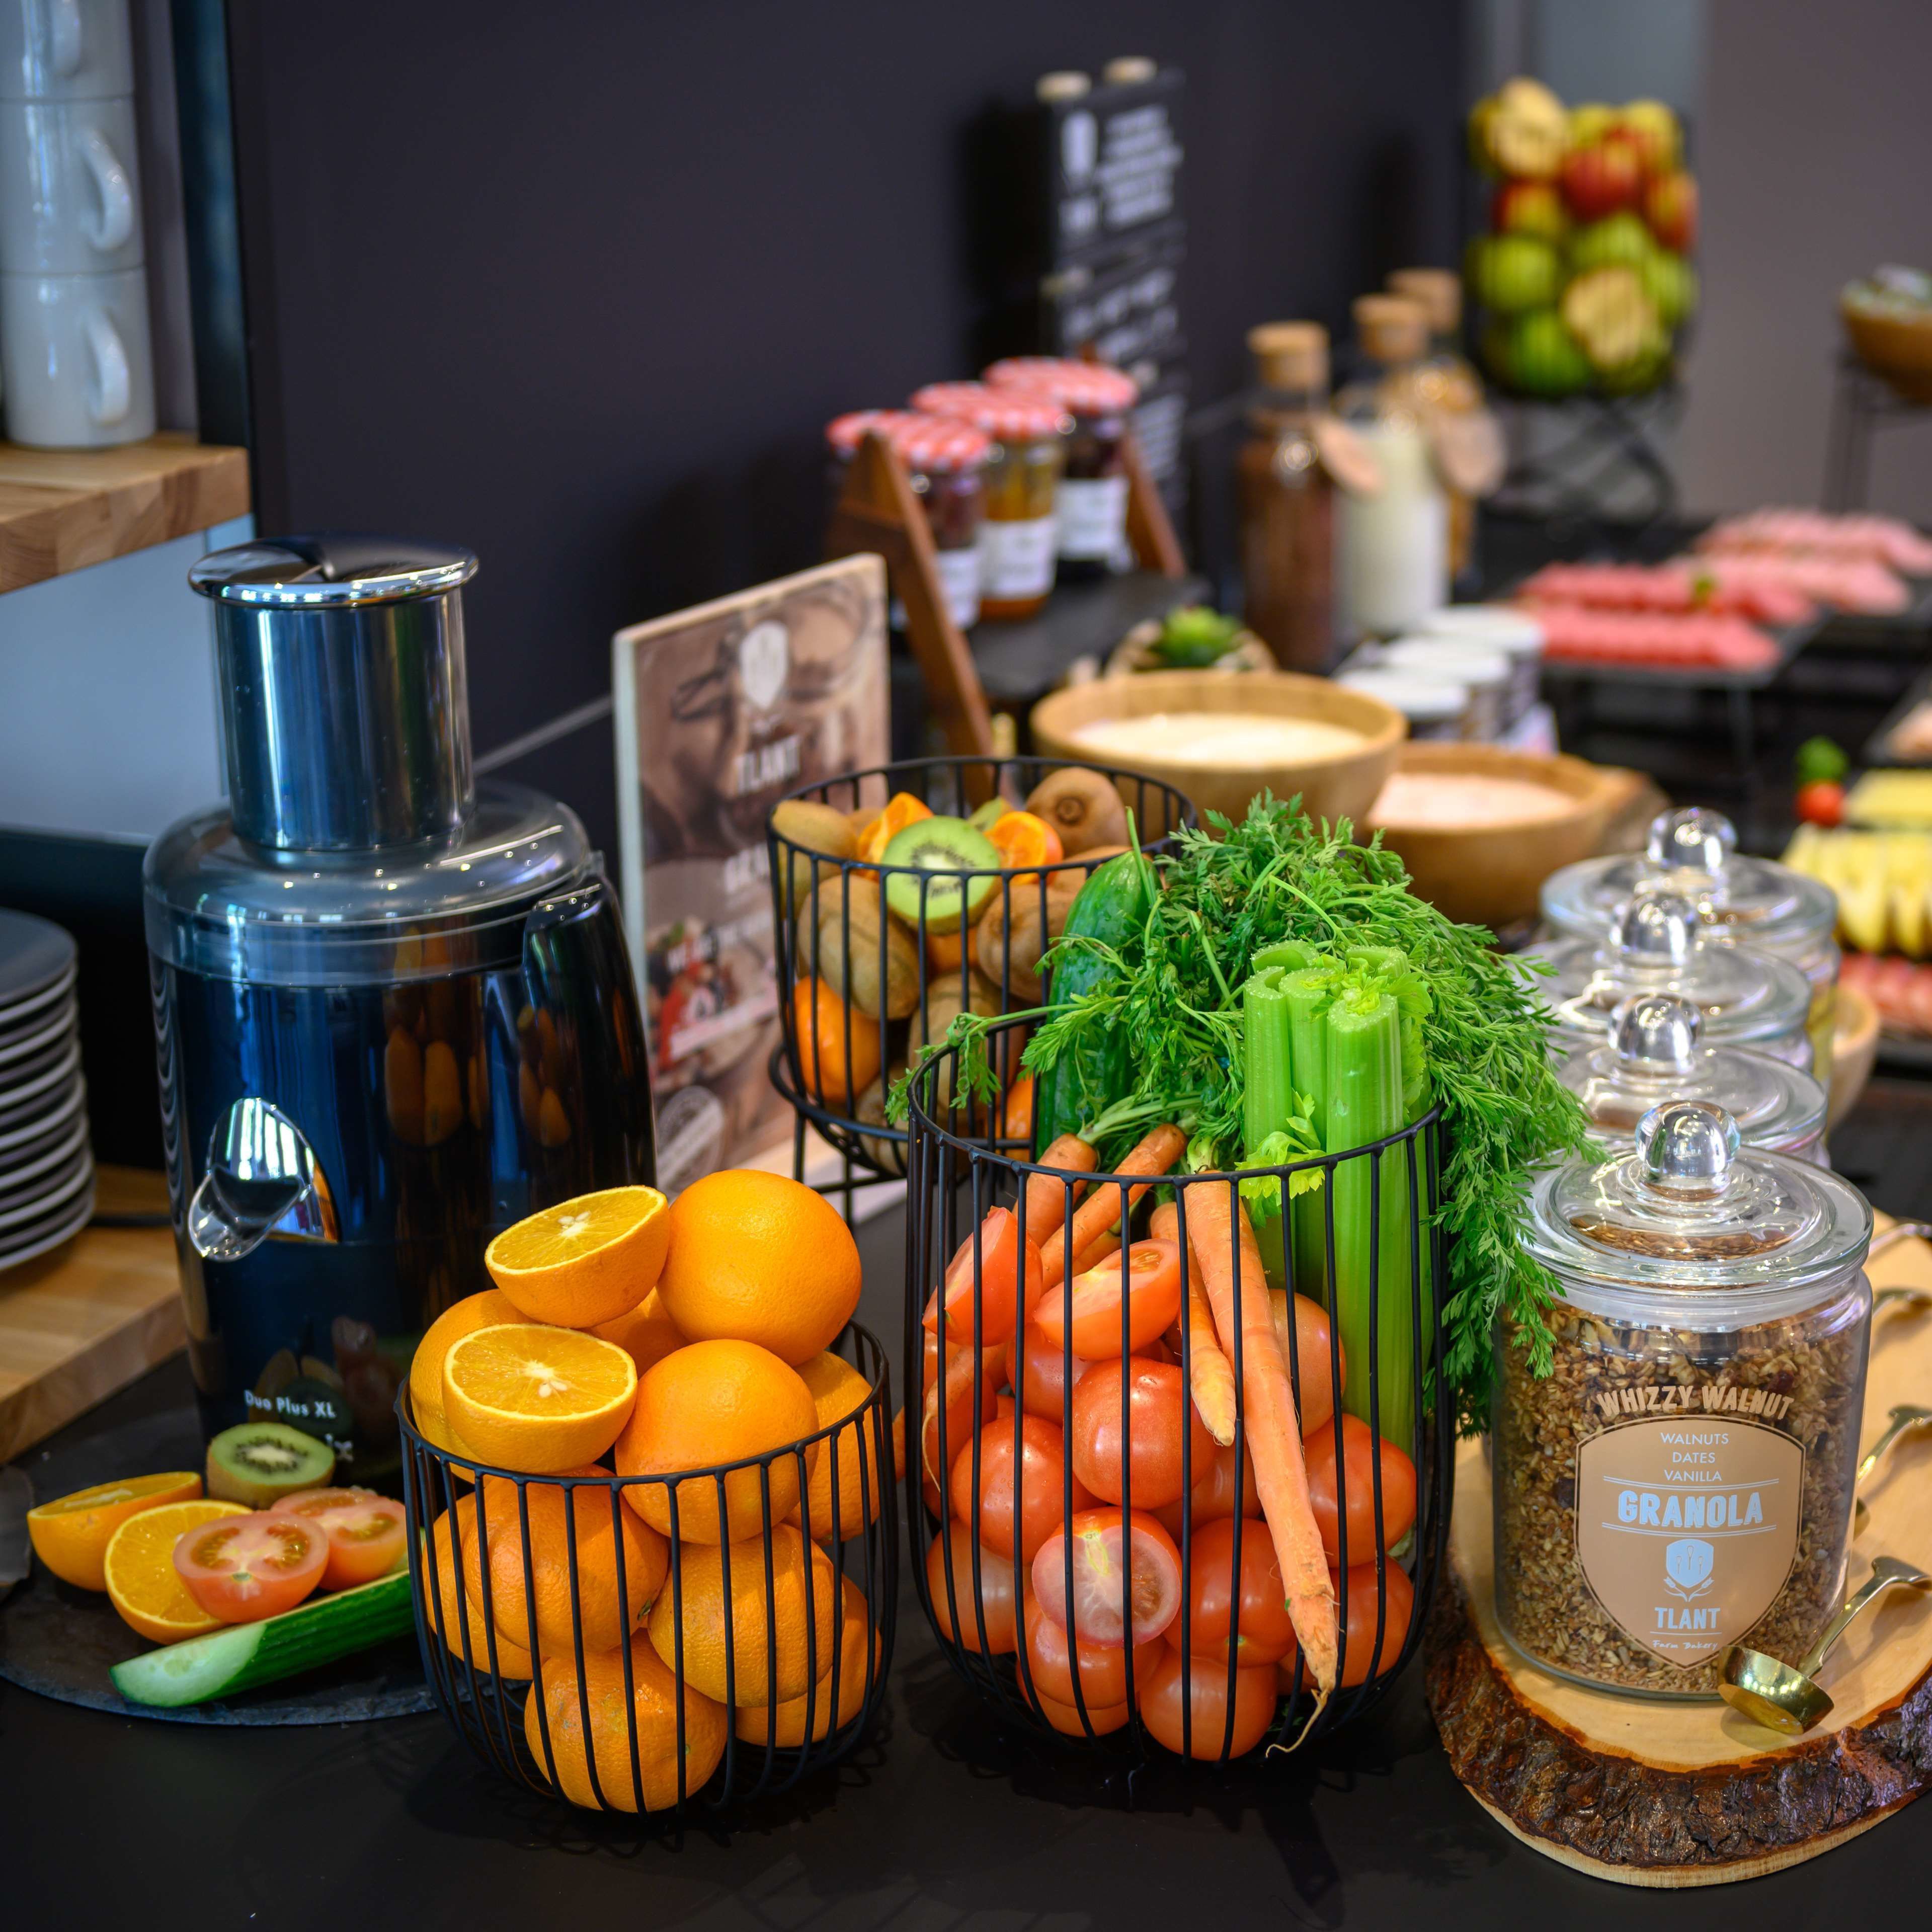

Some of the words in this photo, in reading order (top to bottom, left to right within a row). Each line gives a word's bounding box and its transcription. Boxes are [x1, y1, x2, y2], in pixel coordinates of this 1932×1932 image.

[245, 1390, 272, 1410] Duo
[276, 1397, 309, 1416] Plus
[314, 1401, 337, 1418] XL
[1597, 1386, 1694, 1417] WHIZZY
[1702, 1387, 1794, 1420] WALNUT
[1660, 1432, 1729, 1445] WALNUTS
[1672, 1452, 1716, 1464] DATES
[1664, 1470, 1723, 1482] VANILLA
[1618, 1490, 1763, 1528] GRANOLA
[1654, 1606, 1721, 1630] TLANT
[1652, 1639, 1679, 1649] Farm
[1682, 1641, 1719, 1651] Bakery
